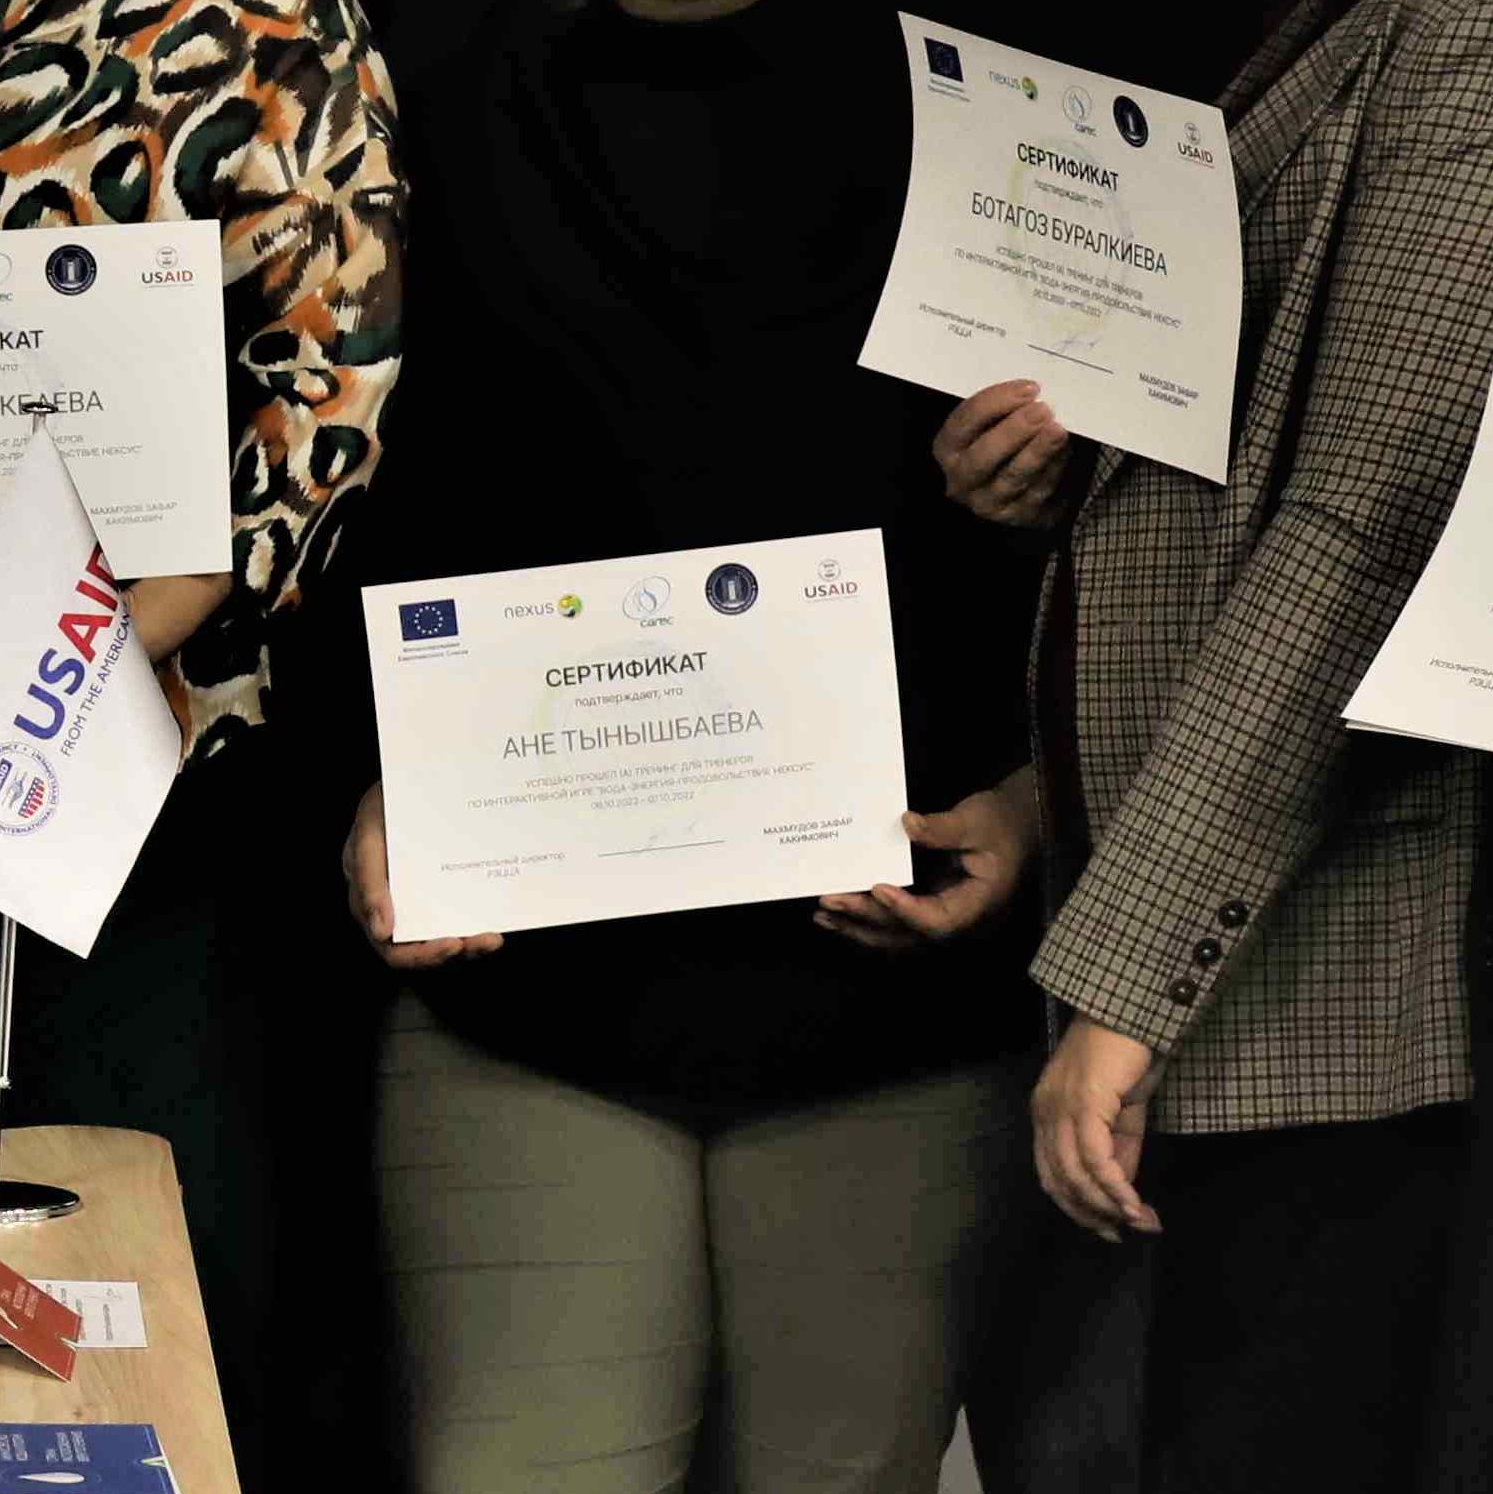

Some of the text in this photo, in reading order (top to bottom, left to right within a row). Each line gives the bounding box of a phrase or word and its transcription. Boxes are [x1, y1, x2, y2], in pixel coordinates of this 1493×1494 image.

[988, 70, 1021, 90] nexus
[1016, 142, 1120, 192] СЕРТИФИКАТ
[1176, 142, 1214, 164] USAID
[971, 192, 1168, 276] БОТАГОЗ БУРАЛКИЕВА
[141, 269, 194, 285] USAID
[803, 580, 859, 601] USAID
[503, 601, 555, 621] nexus
[544, 650, 708, 689] СЕРТИФИКАТ
[60, 714, 88, 758] FROM
[80, 682, 104, 718] THE
[501, 708, 764, 761] АНЕ ТЫНЫШБАЕВА
